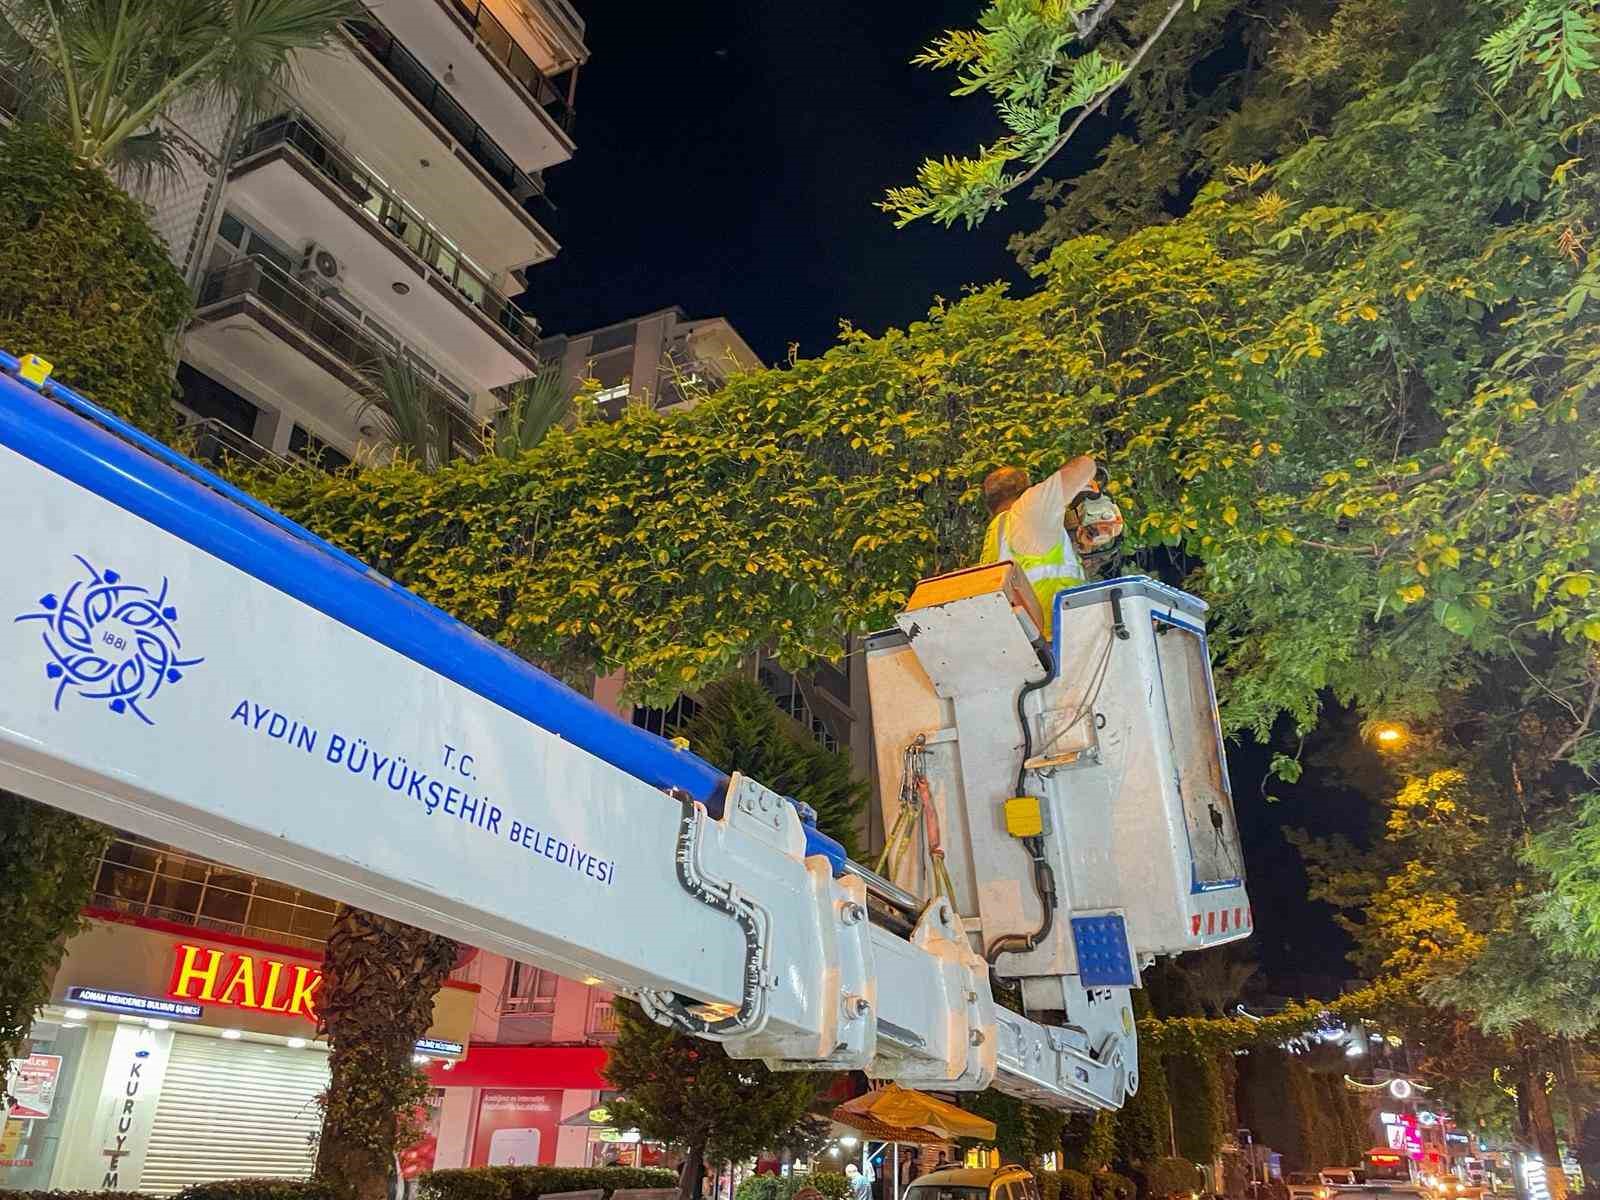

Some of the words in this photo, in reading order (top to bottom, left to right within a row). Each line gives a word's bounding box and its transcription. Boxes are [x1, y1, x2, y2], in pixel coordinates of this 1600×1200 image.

[102, 630, 127, 651] 1881
[443, 744, 477, 781] T.C.
[230, 700, 318, 753] AYDIN
[326, 734, 503, 835] BÜYÜKŞEHİR
[509, 820, 616, 886] BELEDİYESİ
[172, 944, 323, 1021] HALK
